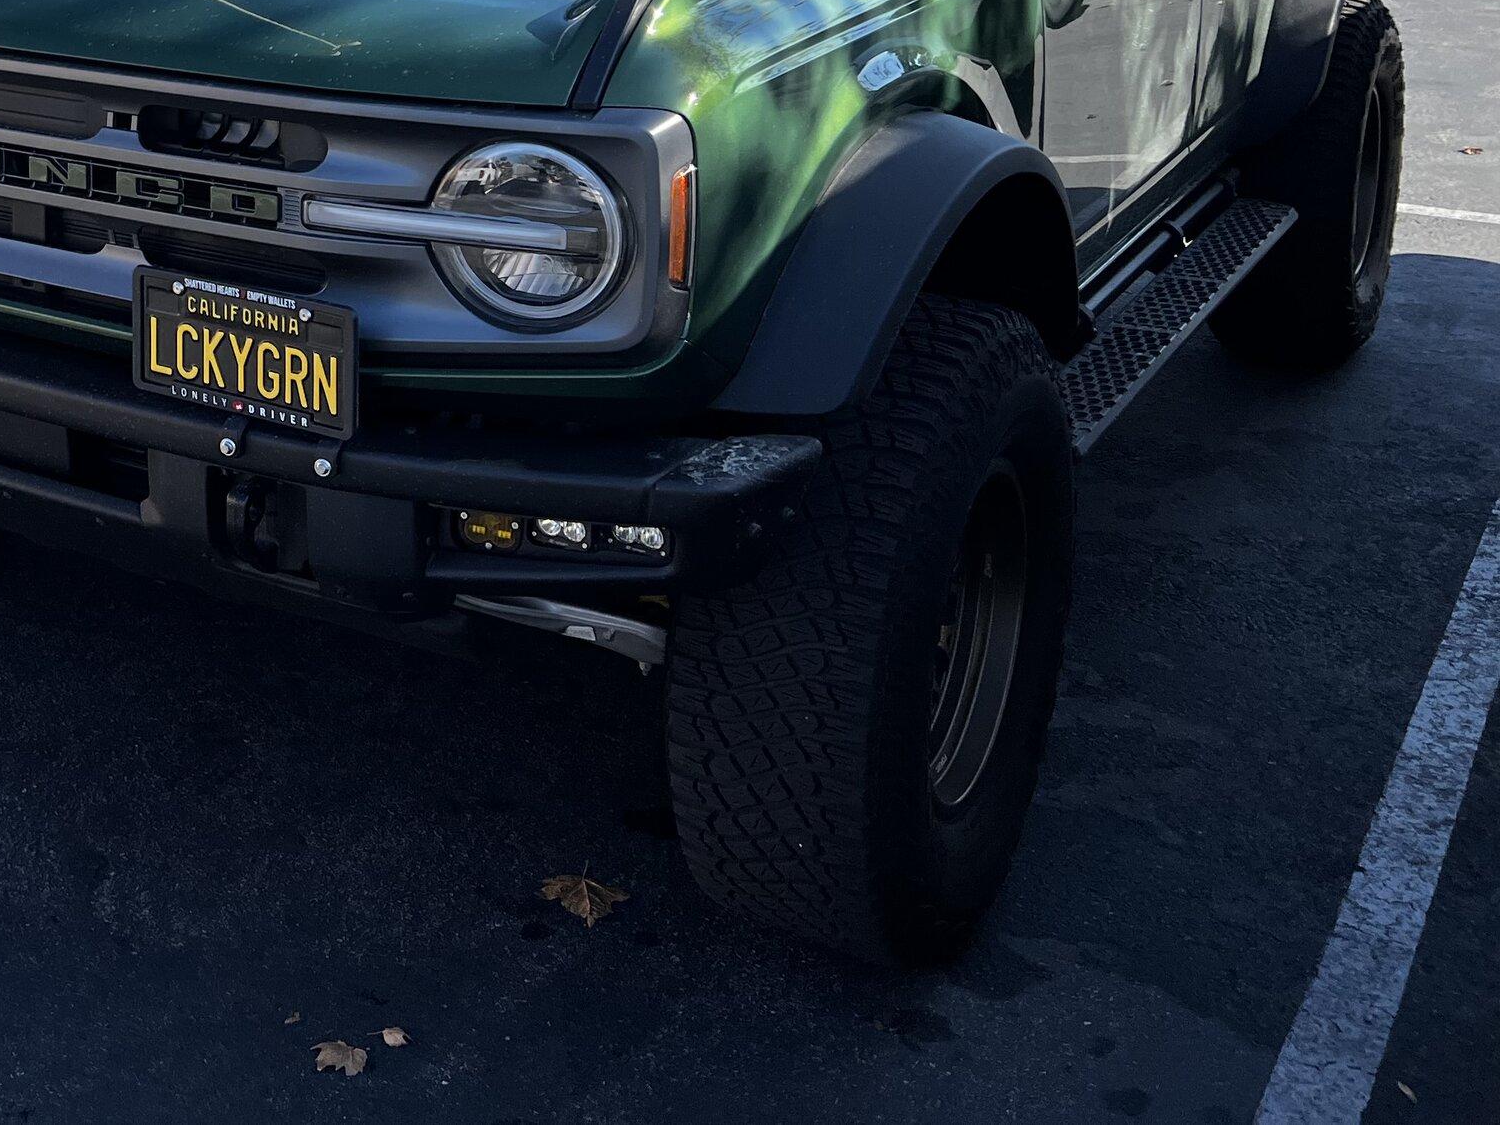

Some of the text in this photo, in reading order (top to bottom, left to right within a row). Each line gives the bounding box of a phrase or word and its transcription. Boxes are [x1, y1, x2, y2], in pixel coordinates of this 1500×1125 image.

[184, 277, 240, 298] SHATTERED HEARTS
[246, 290, 296, 310] EMPTY WALLETS
[187, 296, 299, 336] CALIFORNIA
[150, 316, 337, 416] LCKYGRN
[171, 385, 308, 427] LONELY DRIVER
